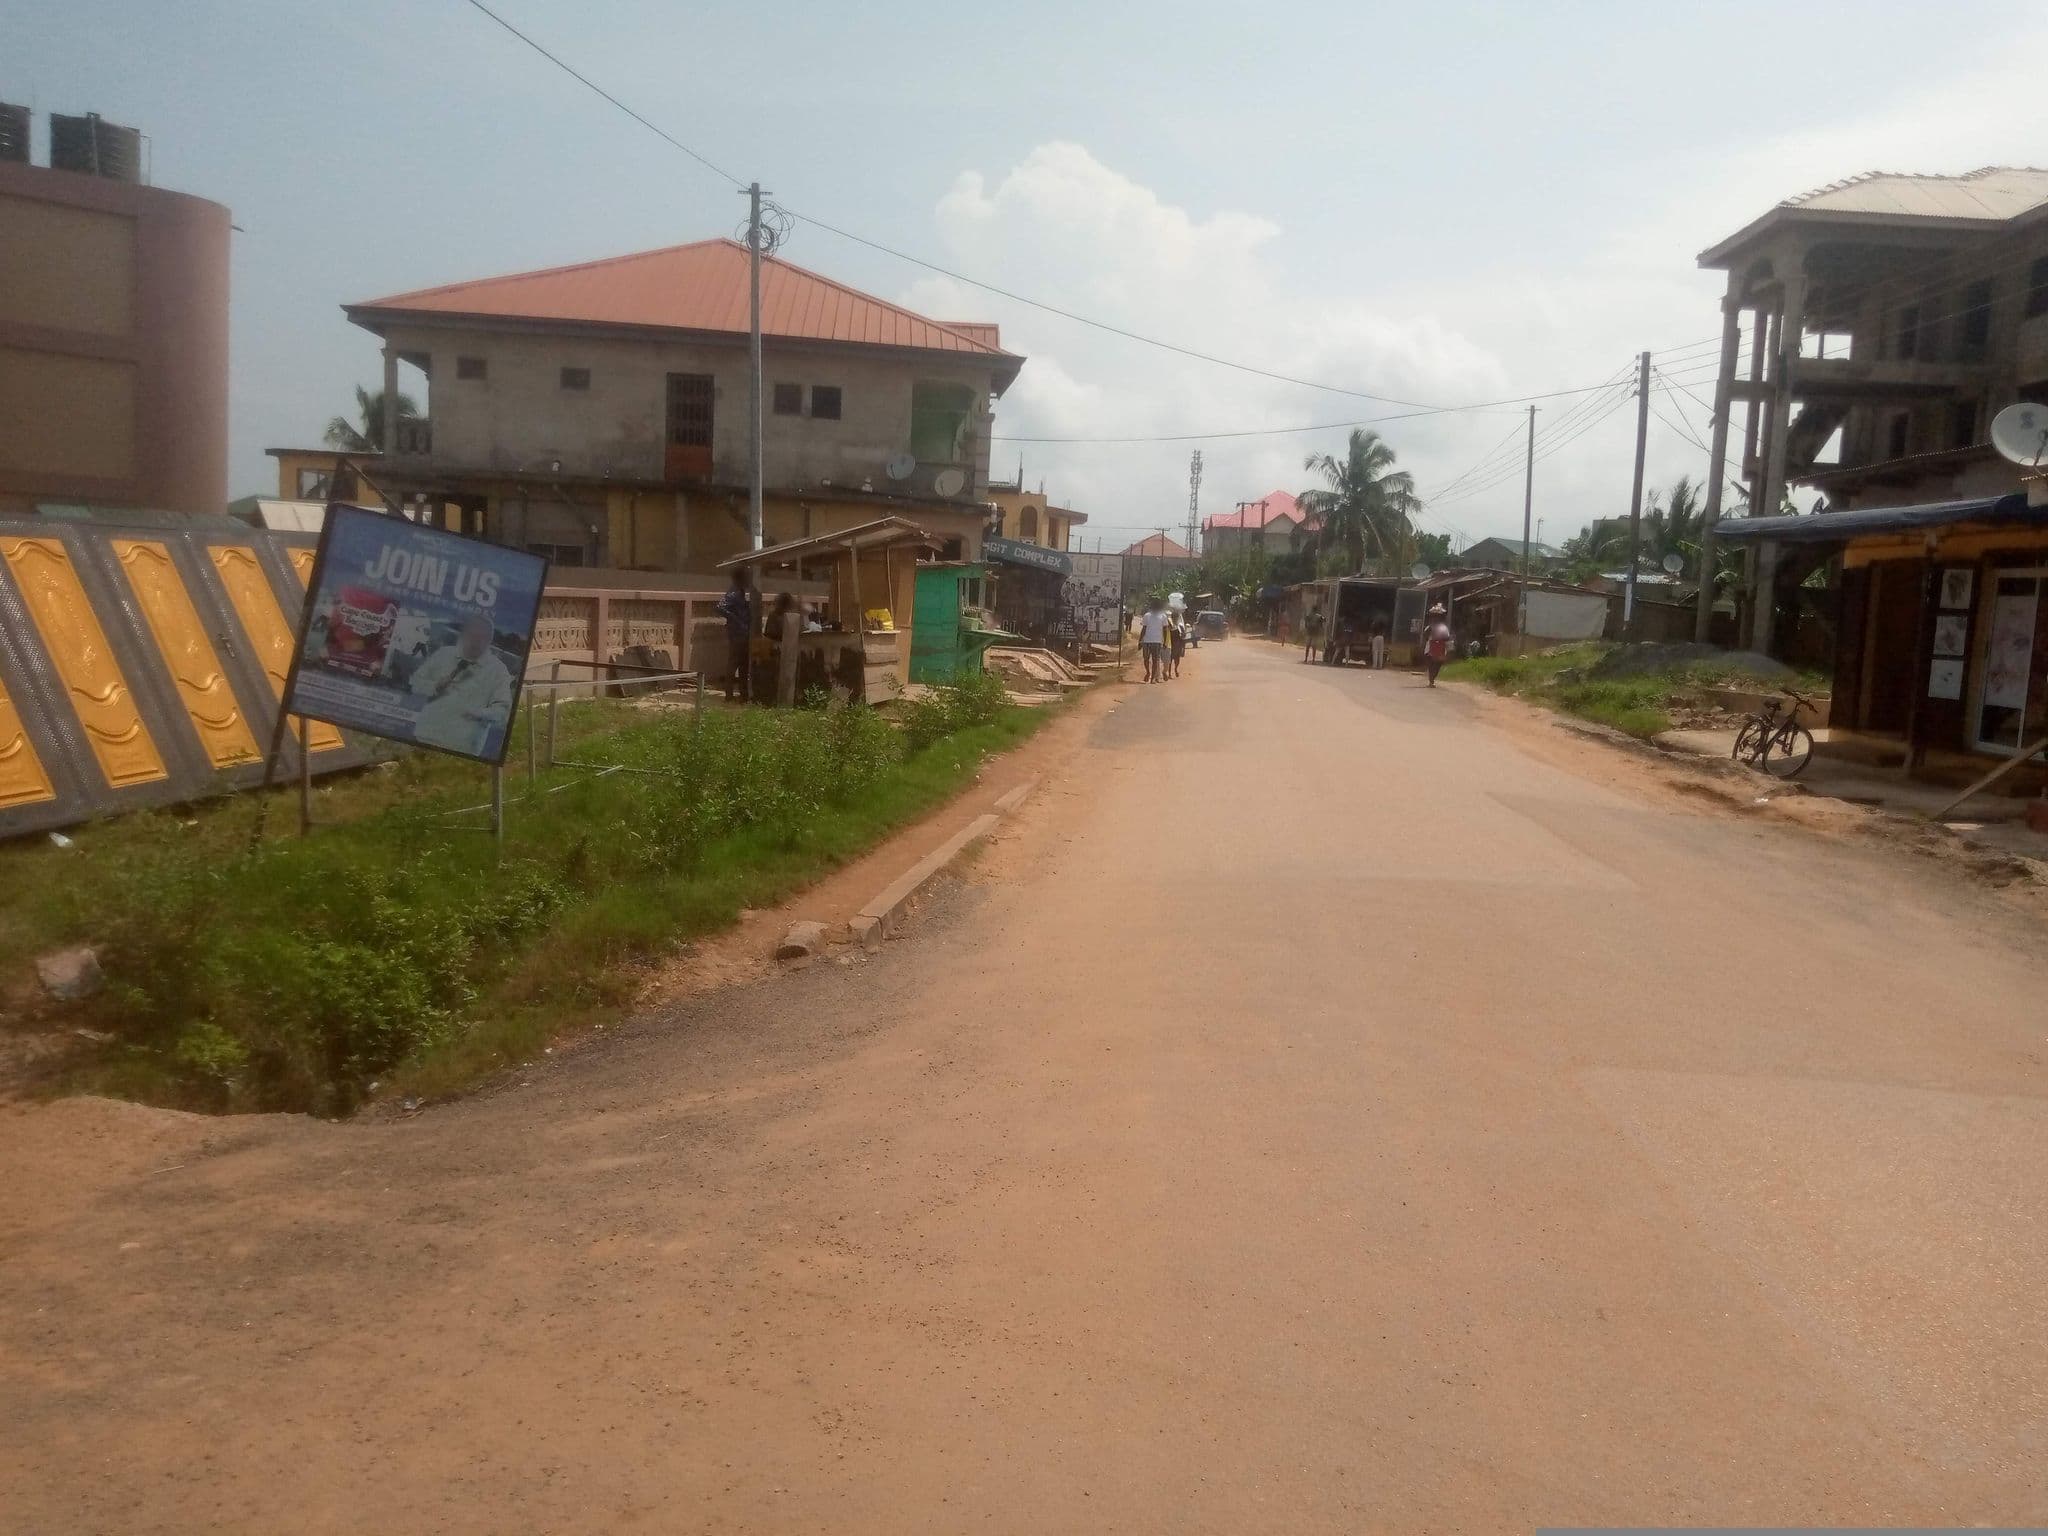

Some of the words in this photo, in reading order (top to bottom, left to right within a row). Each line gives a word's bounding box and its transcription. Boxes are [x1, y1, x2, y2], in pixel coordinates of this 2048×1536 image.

[365, 544, 448, 597] JOIN
[453, 564, 501, 607] US
[1014, 547, 1062, 568] COMPLEX
